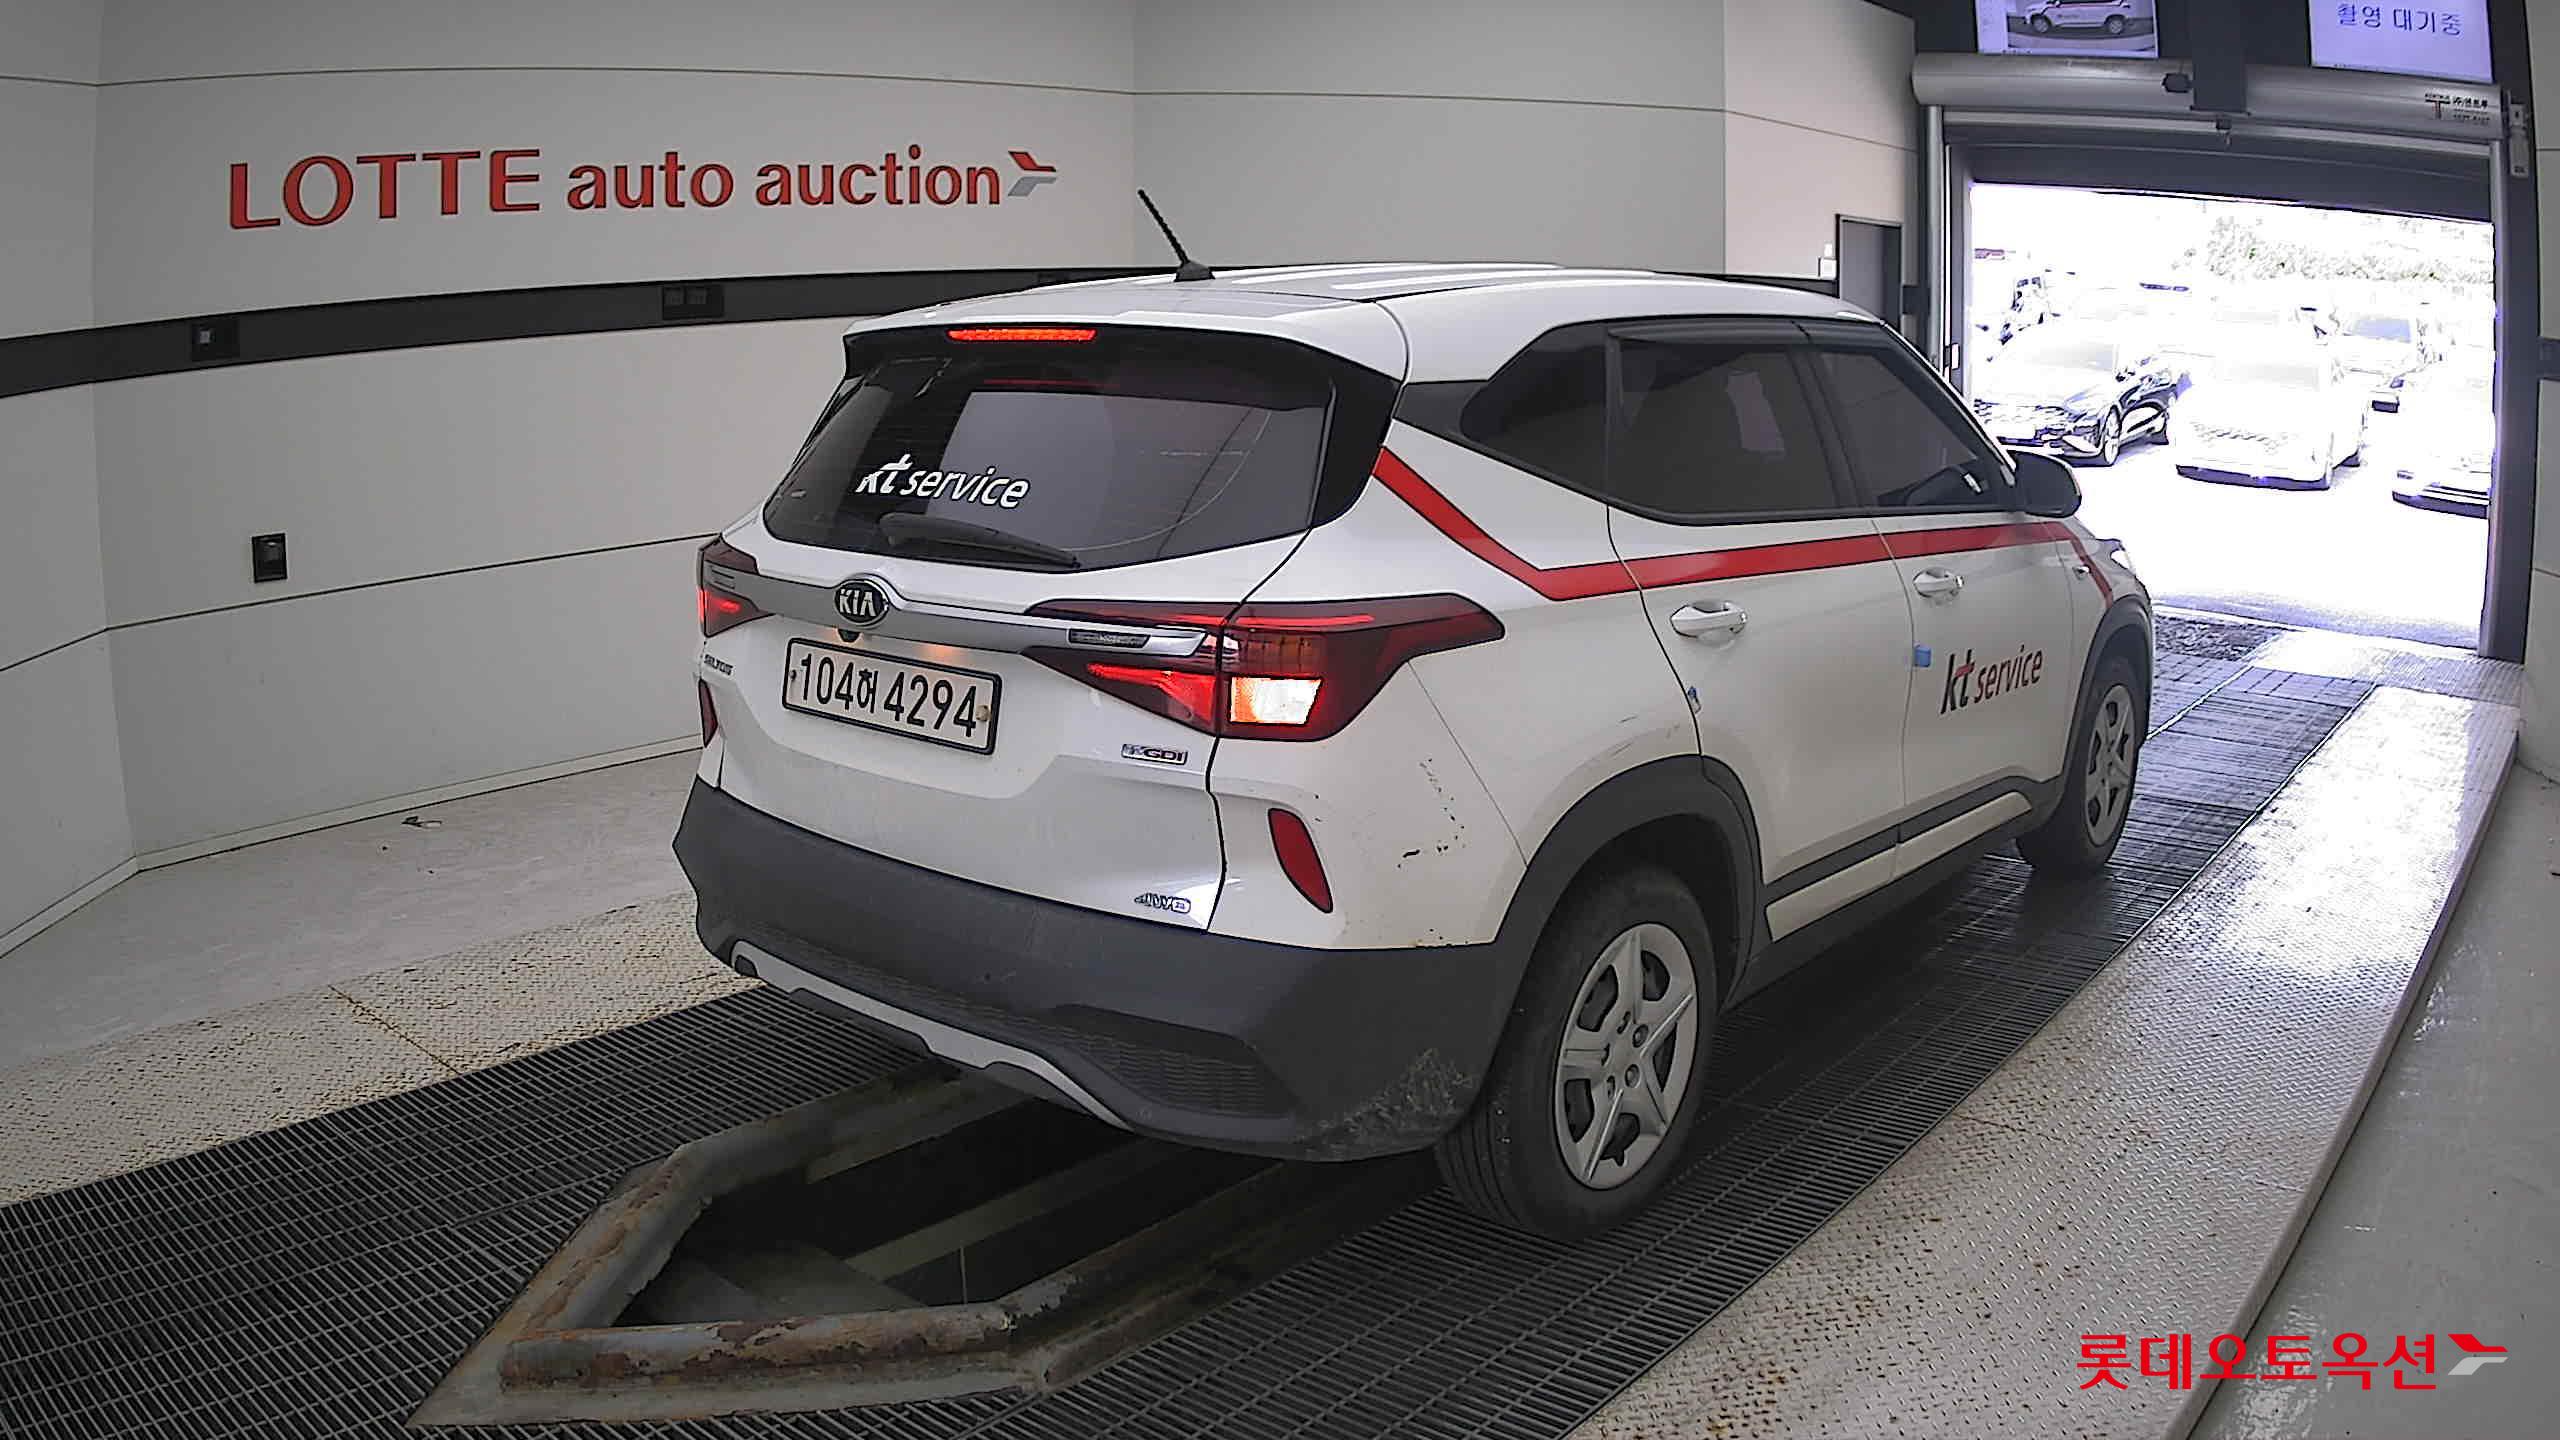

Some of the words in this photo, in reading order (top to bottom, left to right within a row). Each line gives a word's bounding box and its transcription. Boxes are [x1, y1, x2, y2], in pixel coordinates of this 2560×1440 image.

[2393, 8, 2462, 36] 대기중
[229, 149, 541, 230] LOTTE
[566, 151, 735, 209] auto
[755, 144, 1001, 207] auction
[900, 467, 1031, 508] service
[839, 588, 877, 617] KIA
[1941, 649, 1975, 714] kt
[1974, 644, 2043, 703] service
